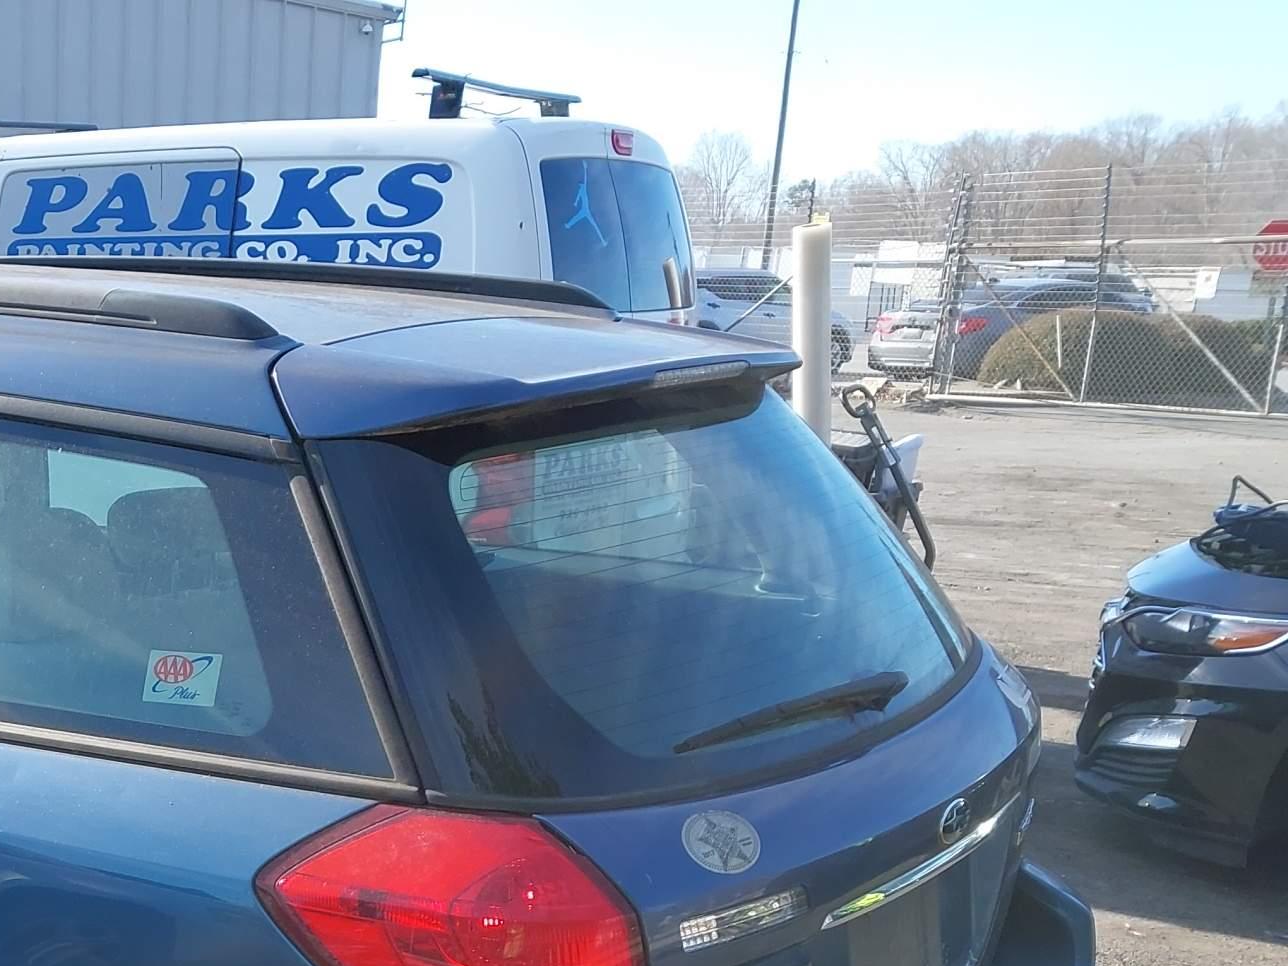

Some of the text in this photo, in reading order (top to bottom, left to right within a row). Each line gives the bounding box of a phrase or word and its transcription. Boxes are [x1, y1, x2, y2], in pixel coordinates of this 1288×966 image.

[12, 162, 453, 234] PARKS
[236, 240, 311, 264] CO.
[334, 238, 435, 264] INC.
[1252, 242, 1288, 256] STO
[156, 656, 191, 682] AAA
[168, 685, 201, 700] Plus
